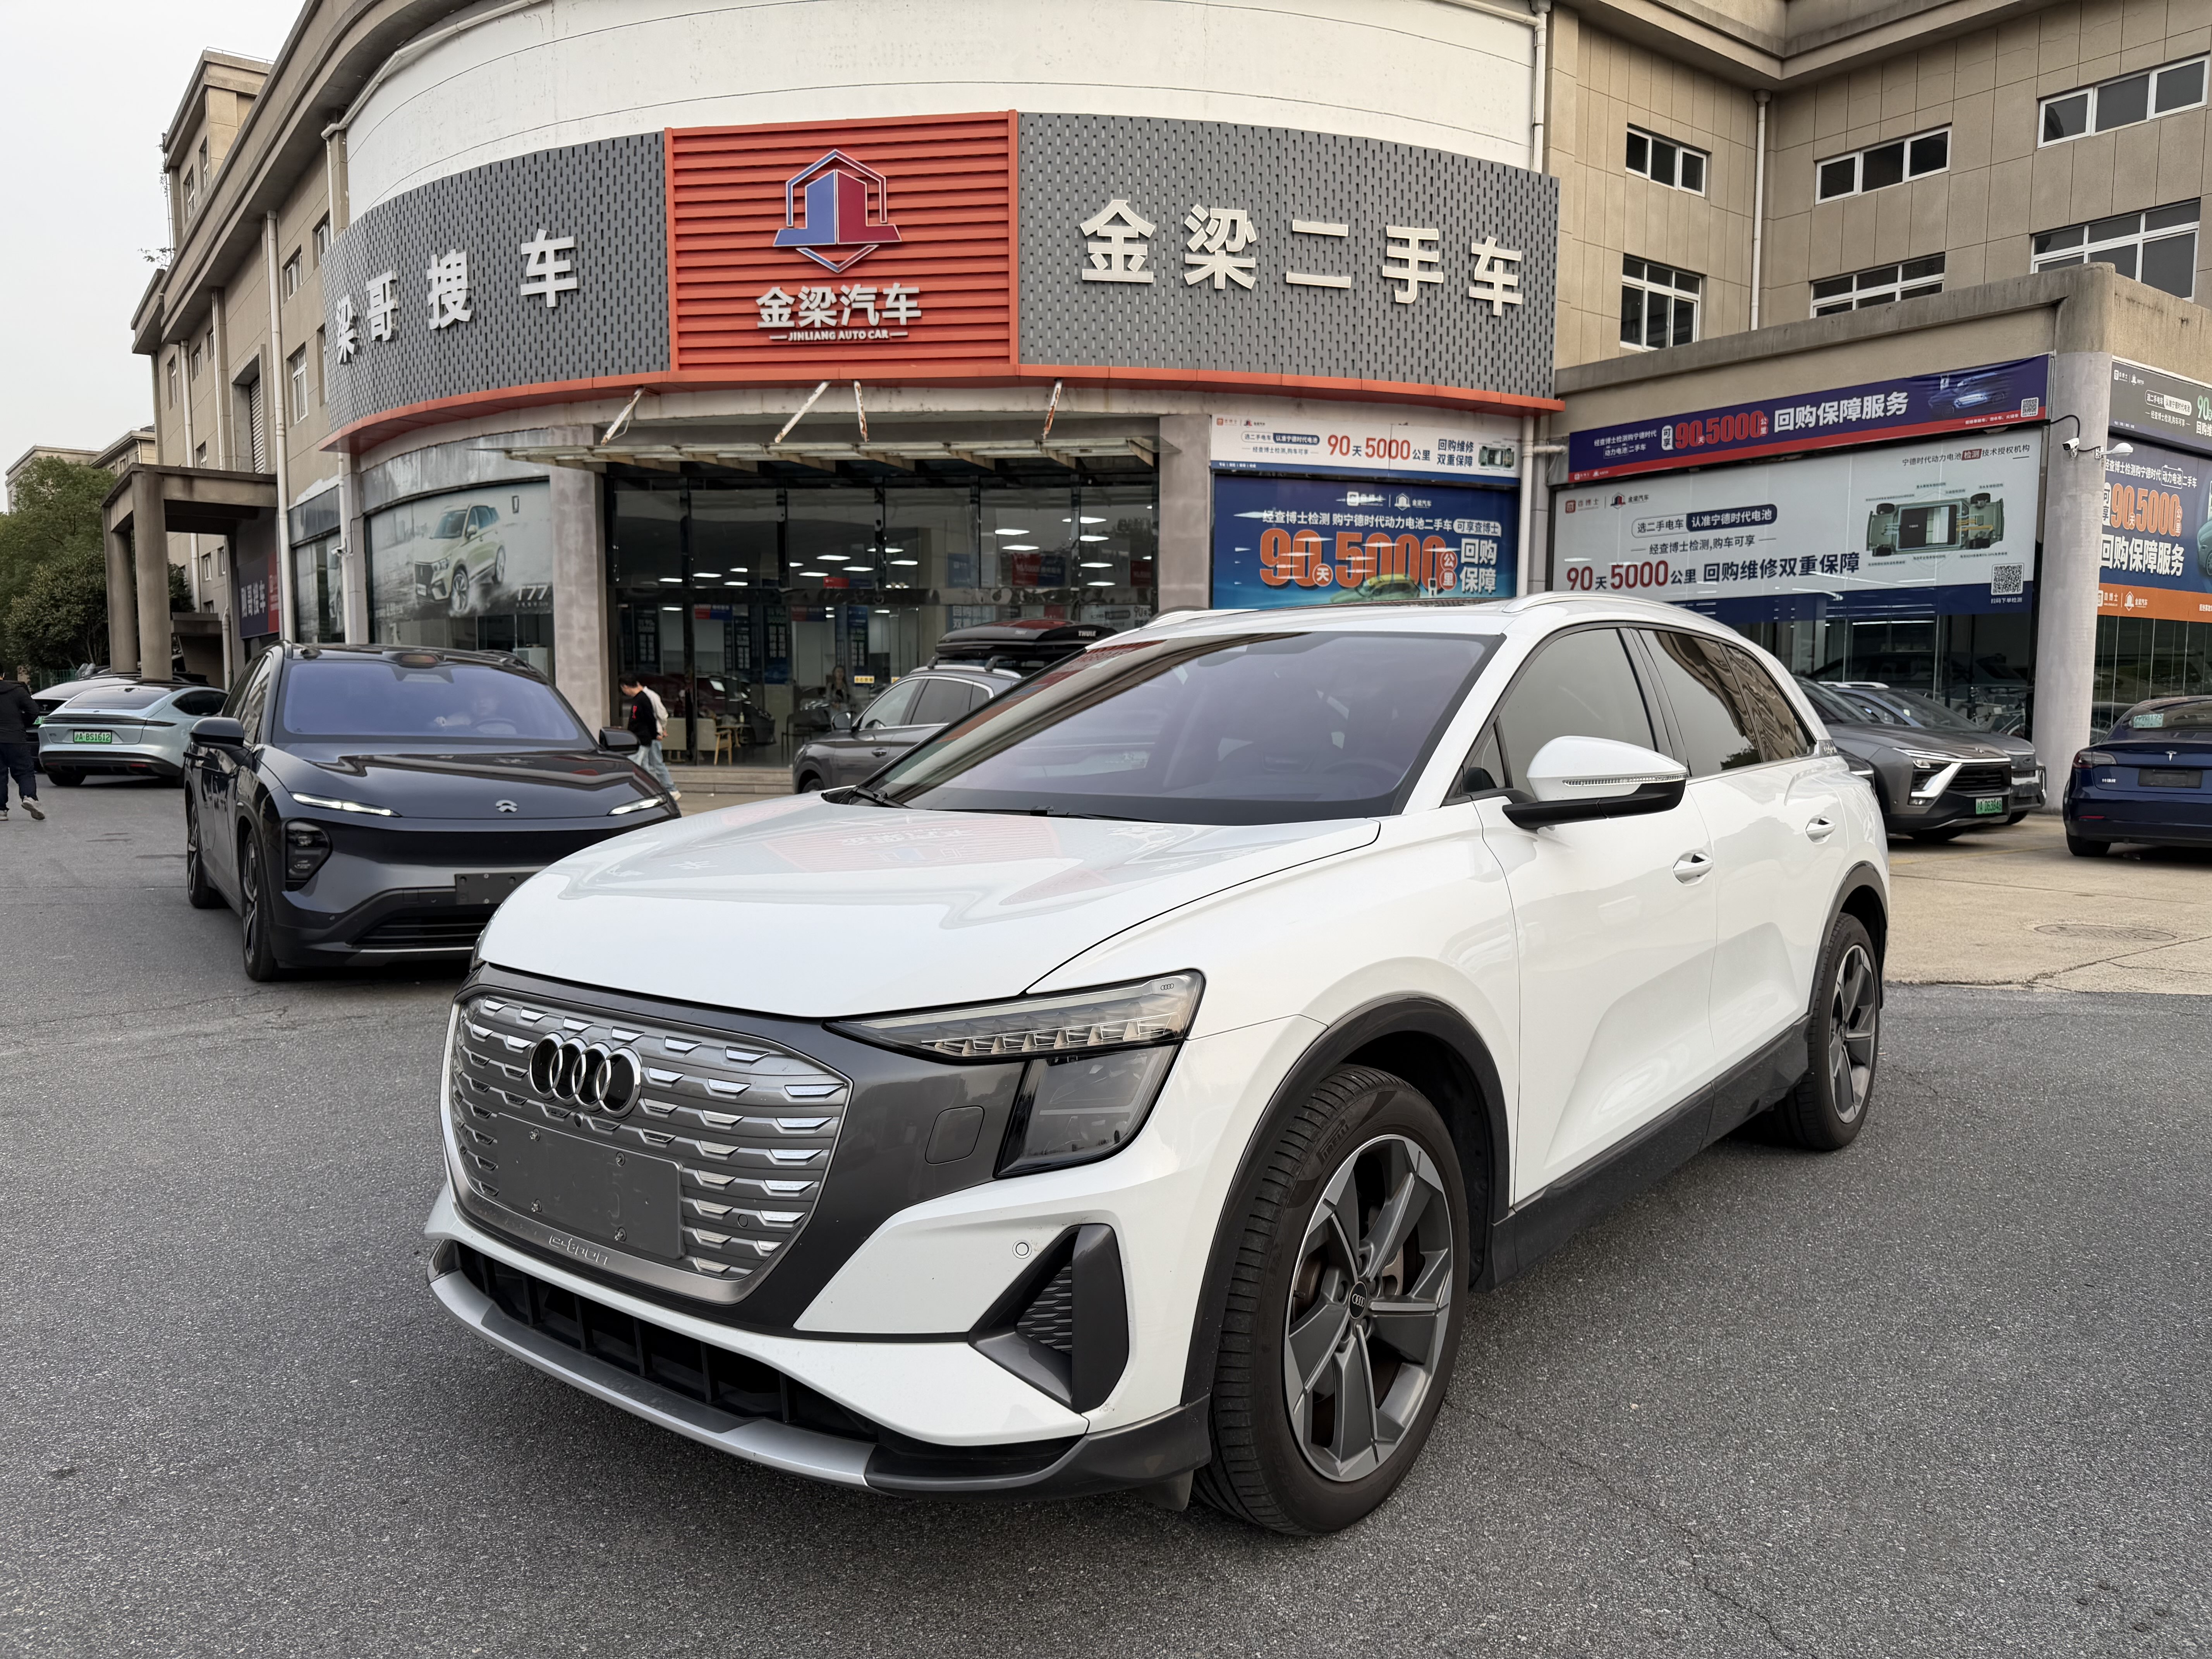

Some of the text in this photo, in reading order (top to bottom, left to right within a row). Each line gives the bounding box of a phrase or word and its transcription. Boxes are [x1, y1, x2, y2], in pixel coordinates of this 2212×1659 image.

[1080, 199, 1523, 316] 金梁二手车
[336, 228, 578, 364] 梁哥搜车
[756, 283, 922, 328] 金梁汽车
[788, 329, 889, 341] JINLIANG AUTO CAR
[1774, 392, 1908, 433] 回购保障服务
[1438, 438, 1474, 453] 回购维修
[1594, 429, 1657, 447] 经查博士检测购宁德时代
[1663, 428, 1671, 447] 可享
[1437, 454, 1473, 467] 双重保障
[1332, 513, 1452, 532] 购宁德时代动力电池二手车
[1457, 521, 1499, 534] 可享查博士
[1637, 508, 1772, 533] 选二手电车 认准宁德时代电池
[1461, 538, 1497, 565] 回购
[2100, 533, 2185, 576] 回购保障服务
[1459, 567, 1496, 594] 保障
[1703, 552, 1860, 582] 回购维修双重保障
[1316, 1119, 1349, 1165] PIRELLI
[549, 1234, 610, 1266] e-tron
